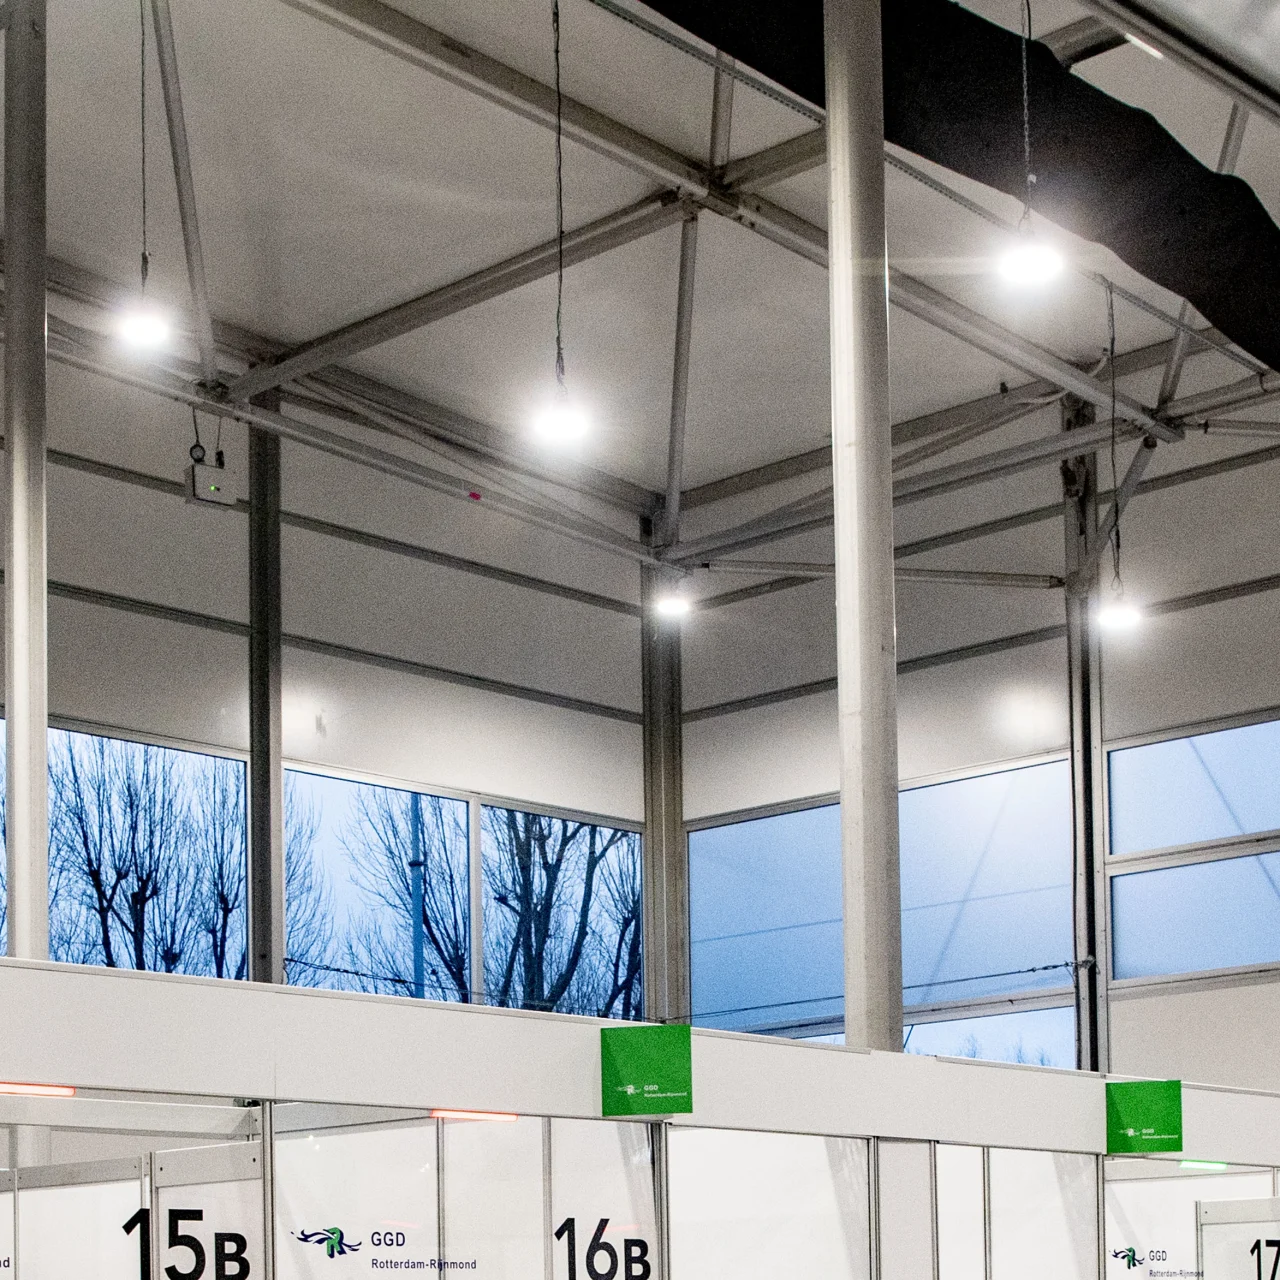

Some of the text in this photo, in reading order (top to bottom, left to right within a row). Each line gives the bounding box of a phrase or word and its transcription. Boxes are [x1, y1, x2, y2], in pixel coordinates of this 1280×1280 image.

[371, 1232, 405, 1246] GGD
[1149, 1250, 1167, 1261] GGD
[371, 1258, 477, 1271] Rotterdam-Rijnmond
